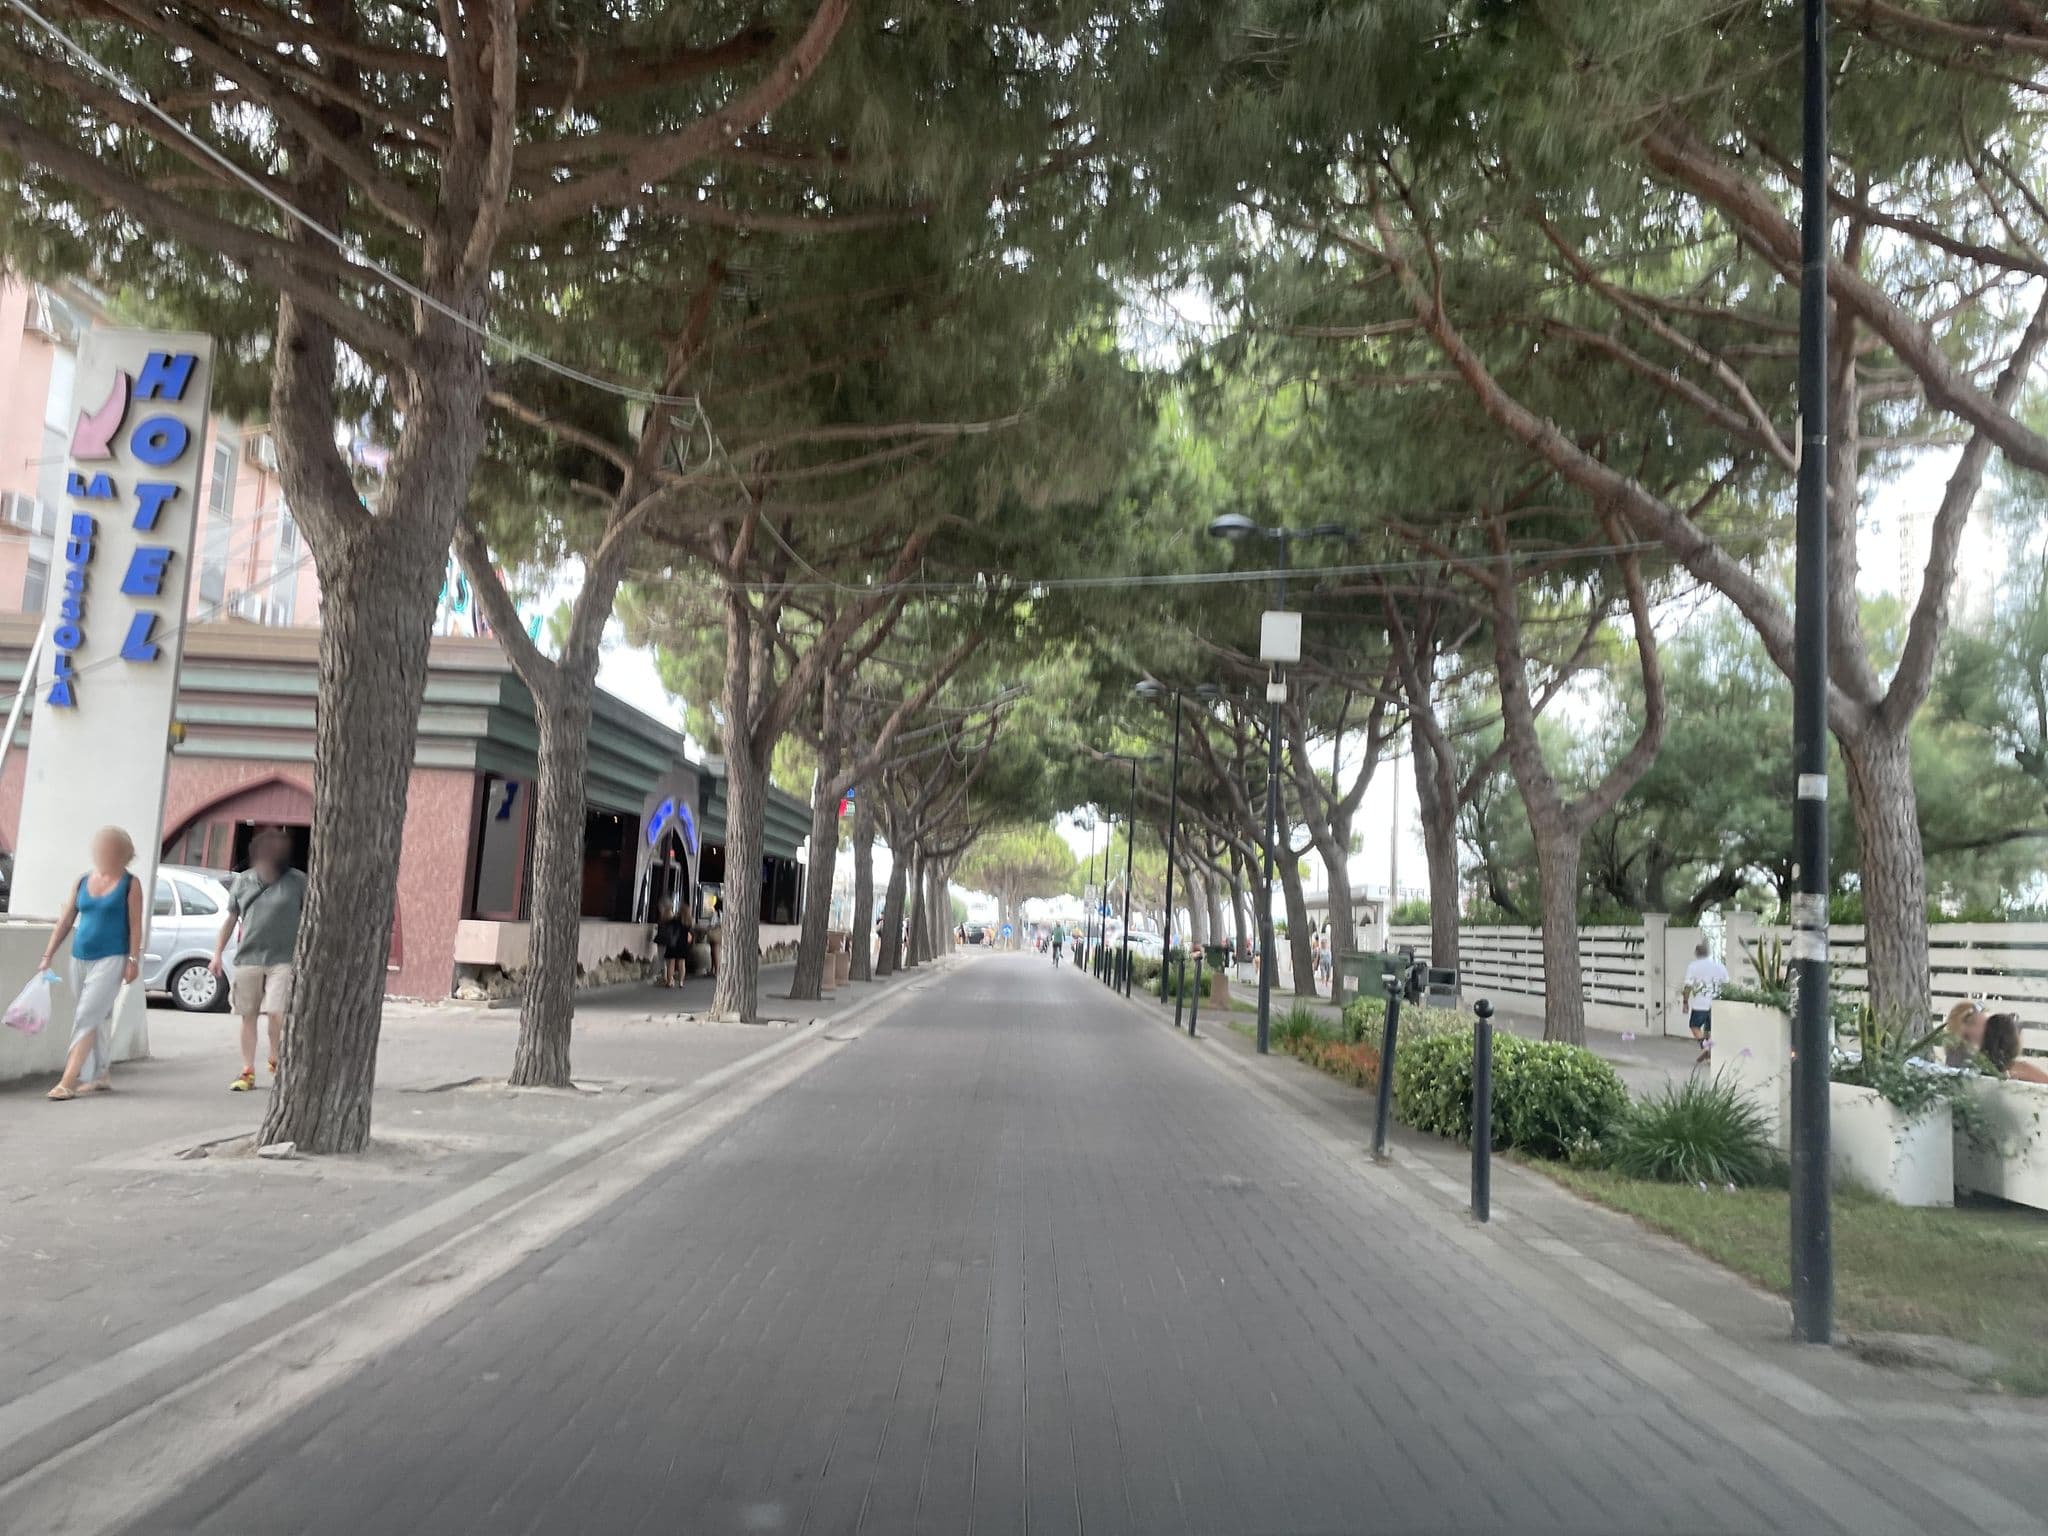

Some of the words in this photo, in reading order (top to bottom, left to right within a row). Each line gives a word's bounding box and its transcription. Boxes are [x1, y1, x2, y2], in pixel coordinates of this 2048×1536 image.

[66, 471, 117, 499] LA
[120, 351, 199, 662] HOTEL
[47, 512, 98, 707] BUSSOLA
